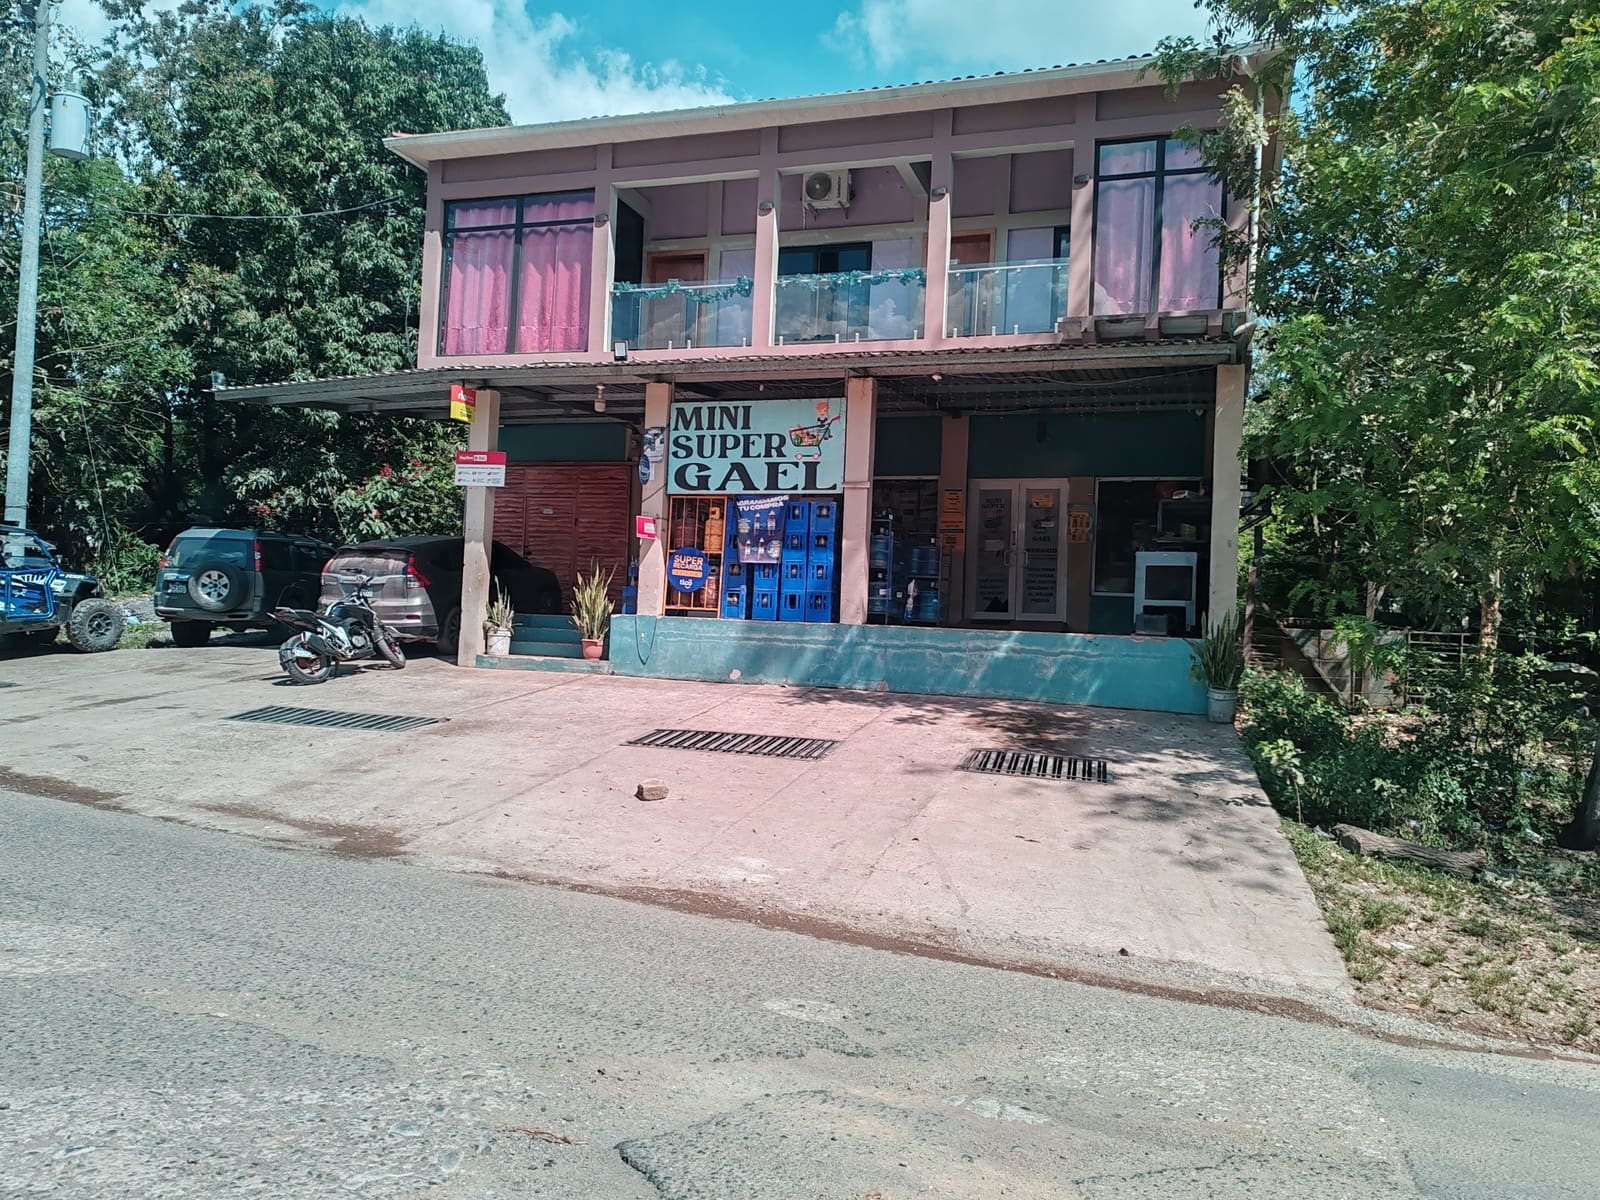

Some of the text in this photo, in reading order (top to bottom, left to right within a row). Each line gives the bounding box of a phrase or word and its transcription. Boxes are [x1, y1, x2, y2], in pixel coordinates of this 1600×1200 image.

[672, 405, 752, 431] MINI
[671, 433, 787, 459] SUPER
[674, 461, 837, 491] GAEL
[750, 501, 784, 511] COMPRA
[673, 554, 704, 566] SUPER
